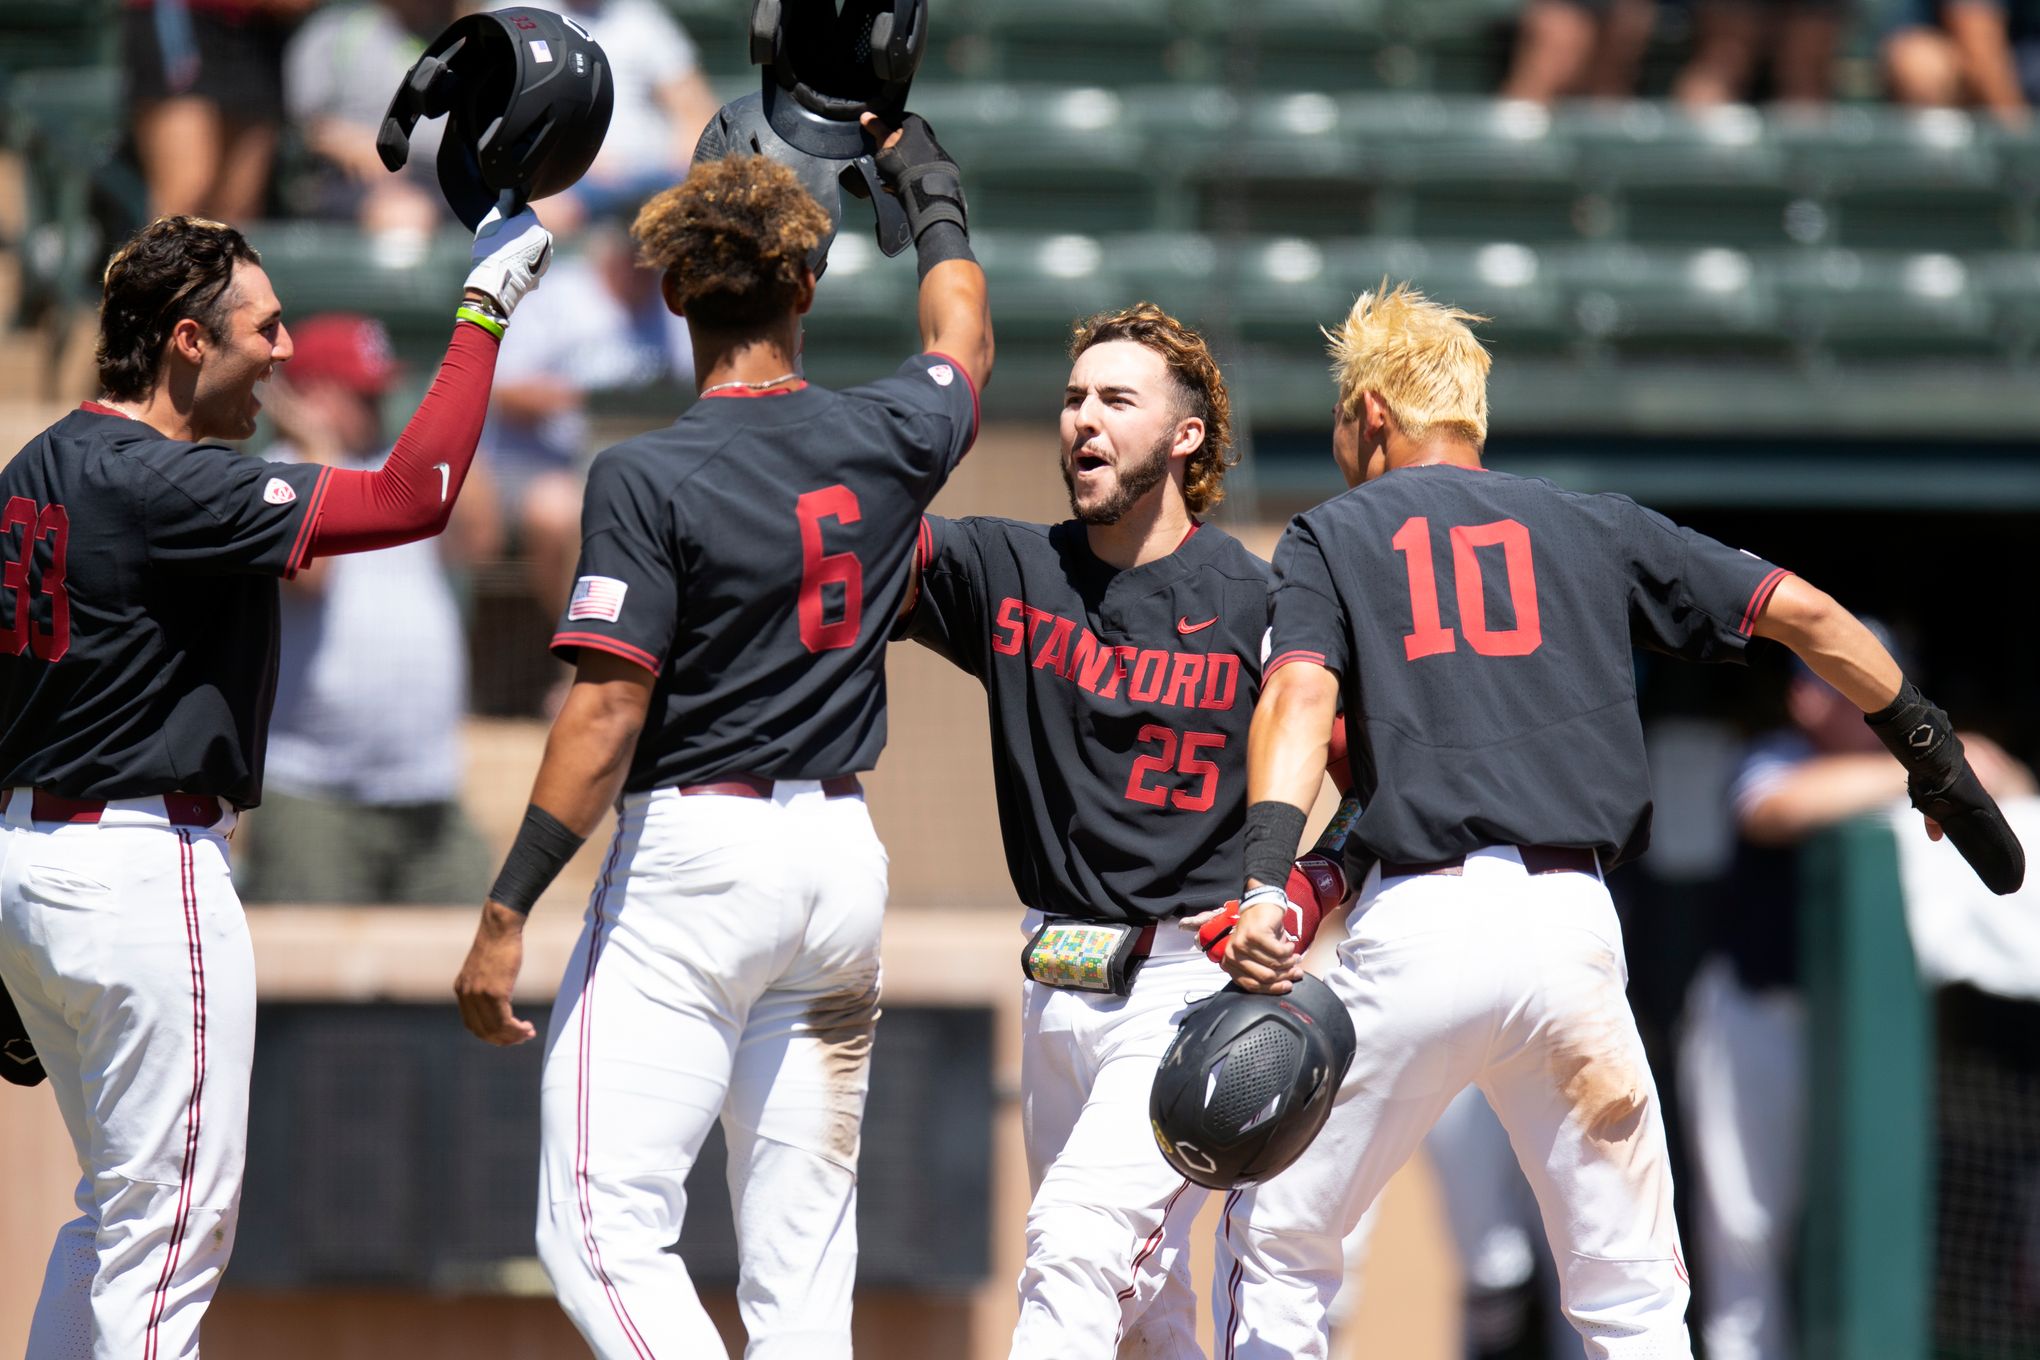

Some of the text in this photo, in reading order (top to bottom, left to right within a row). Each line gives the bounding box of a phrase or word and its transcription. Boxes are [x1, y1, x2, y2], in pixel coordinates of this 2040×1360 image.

[509, 15, 536, 30] 33
[0, 495, 70, 663] 33
[795, 484, 862, 653] 6
[1392, 516, 1542, 662] 10
[992, 597, 1240, 711] STANFORD
[1125, 724, 1227, 812] 25
